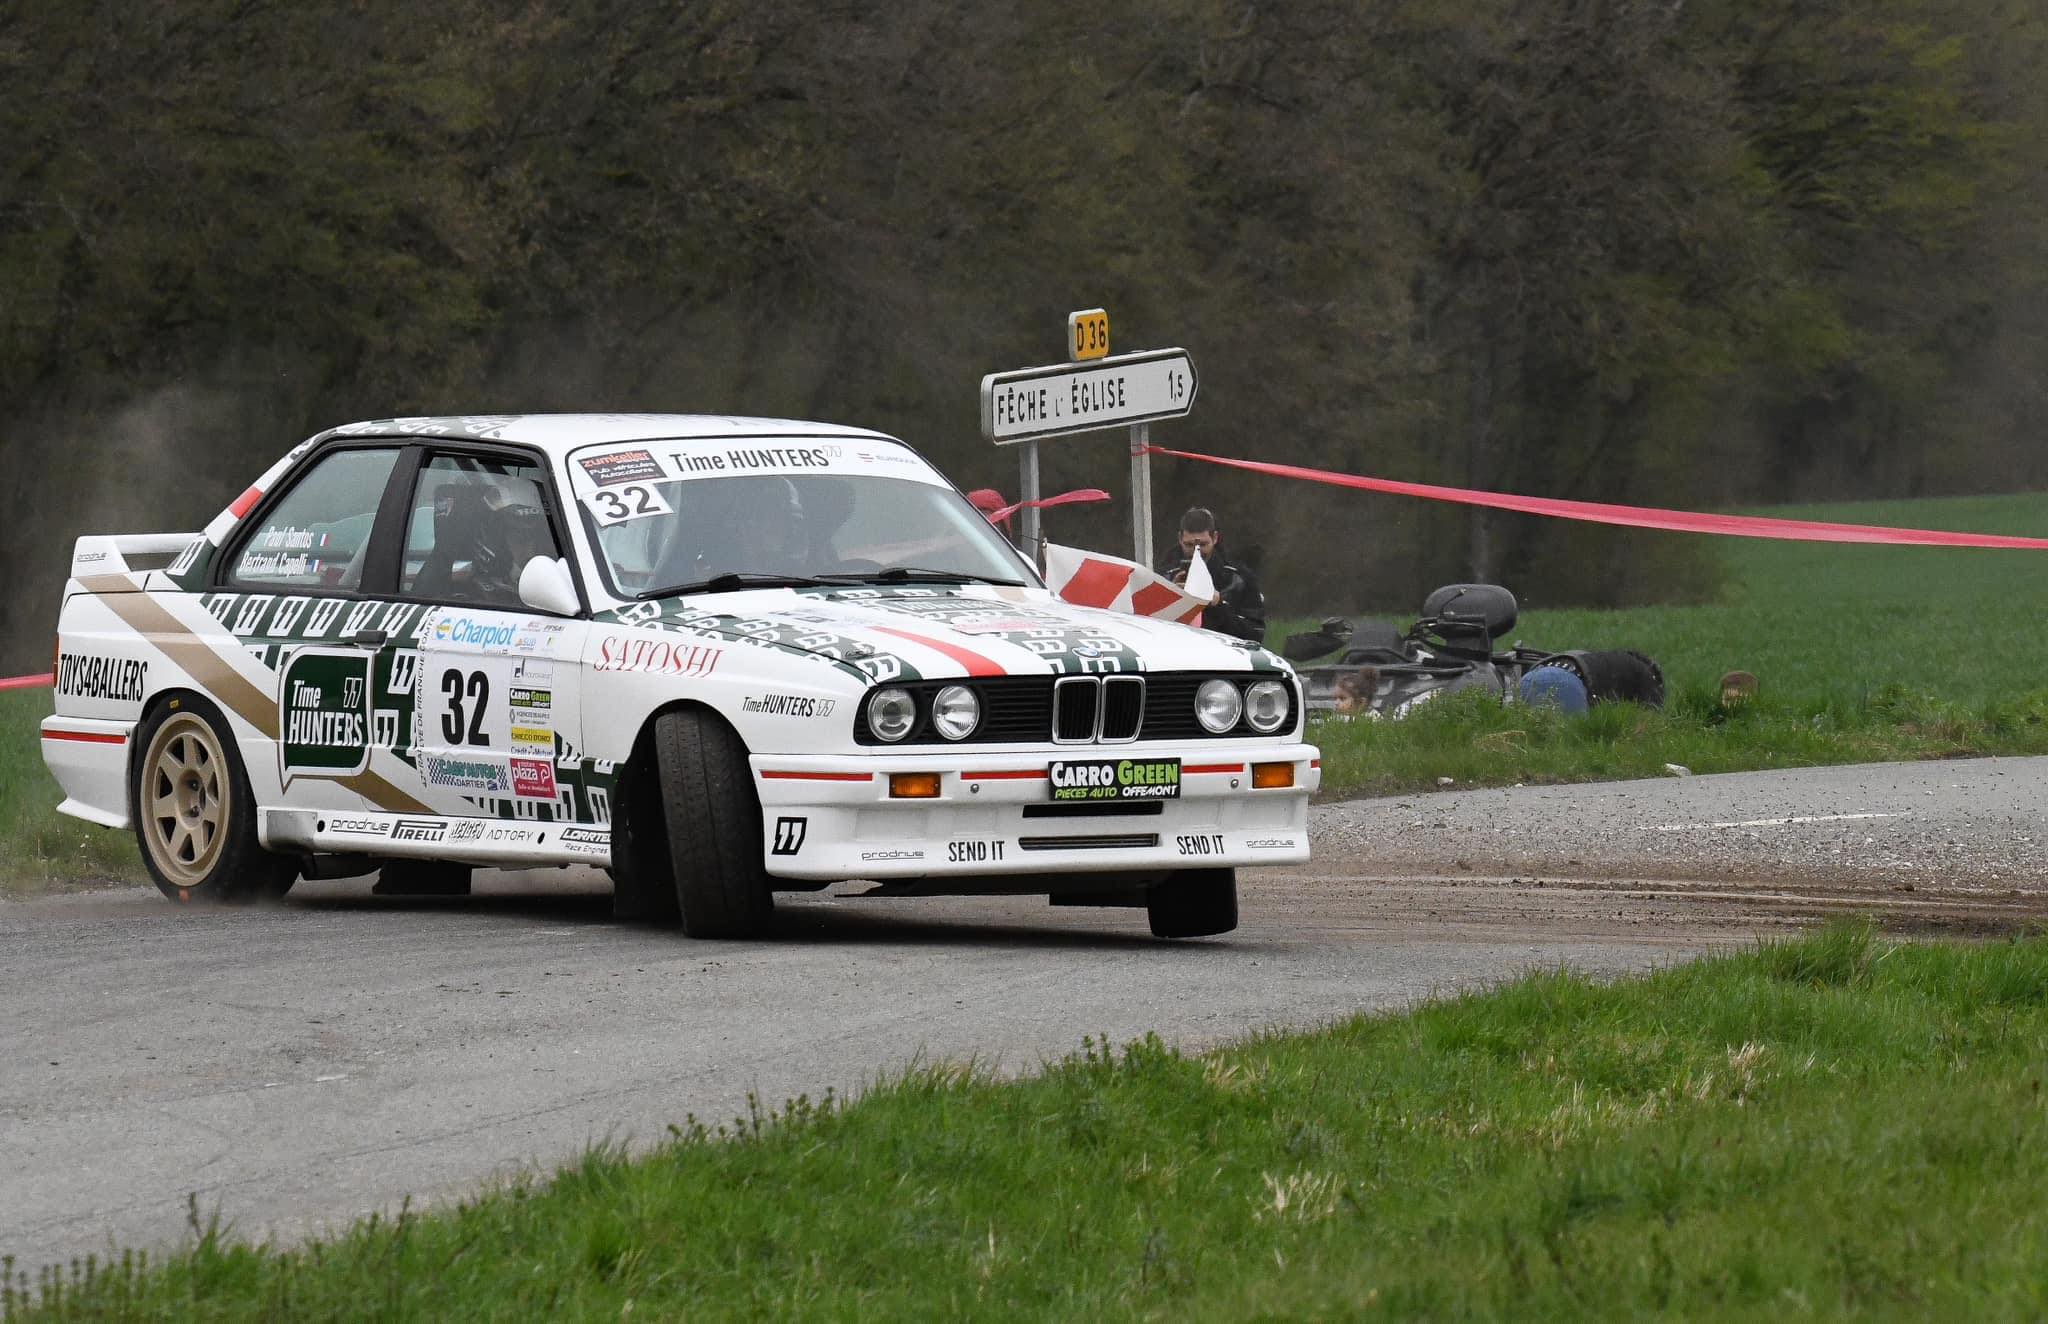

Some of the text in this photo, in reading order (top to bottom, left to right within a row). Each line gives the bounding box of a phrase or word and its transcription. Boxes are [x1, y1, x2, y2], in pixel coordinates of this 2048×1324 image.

[1076, 319, 1106, 351] D 36
[997, 387, 1047, 424] FÊCHE
[1072, 377, 1126, 414] ÉGLISE
[1168, 370, 1184, 402] 1,5
[669, 449, 830, 472] Time HUNTERS
[595, 486, 661, 519] 32
[264, 526, 315, 548] Paul Santos
[240, 551, 281, 573] Bertrand
[451, 618, 517, 649] Charpiot
[593, 635, 724, 678] SATOSHI
[58, 653, 148, 702] TOYS4BALLERS
[292, 680, 322, 708] Time
[441, 668, 490, 747] 32
[287, 710, 364, 747] HUNTERS
[512, 761, 538, 782] plaza
[1051, 760, 1178, 787] CARRO GREEN
[1055, 785, 1177, 799] PIECES AUTO OFFEMONT
[390, 819, 448, 842] PIRELLI
[948, 840, 1005, 862] SEND IT
[1176, 834, 1225, 855] SEND IT
